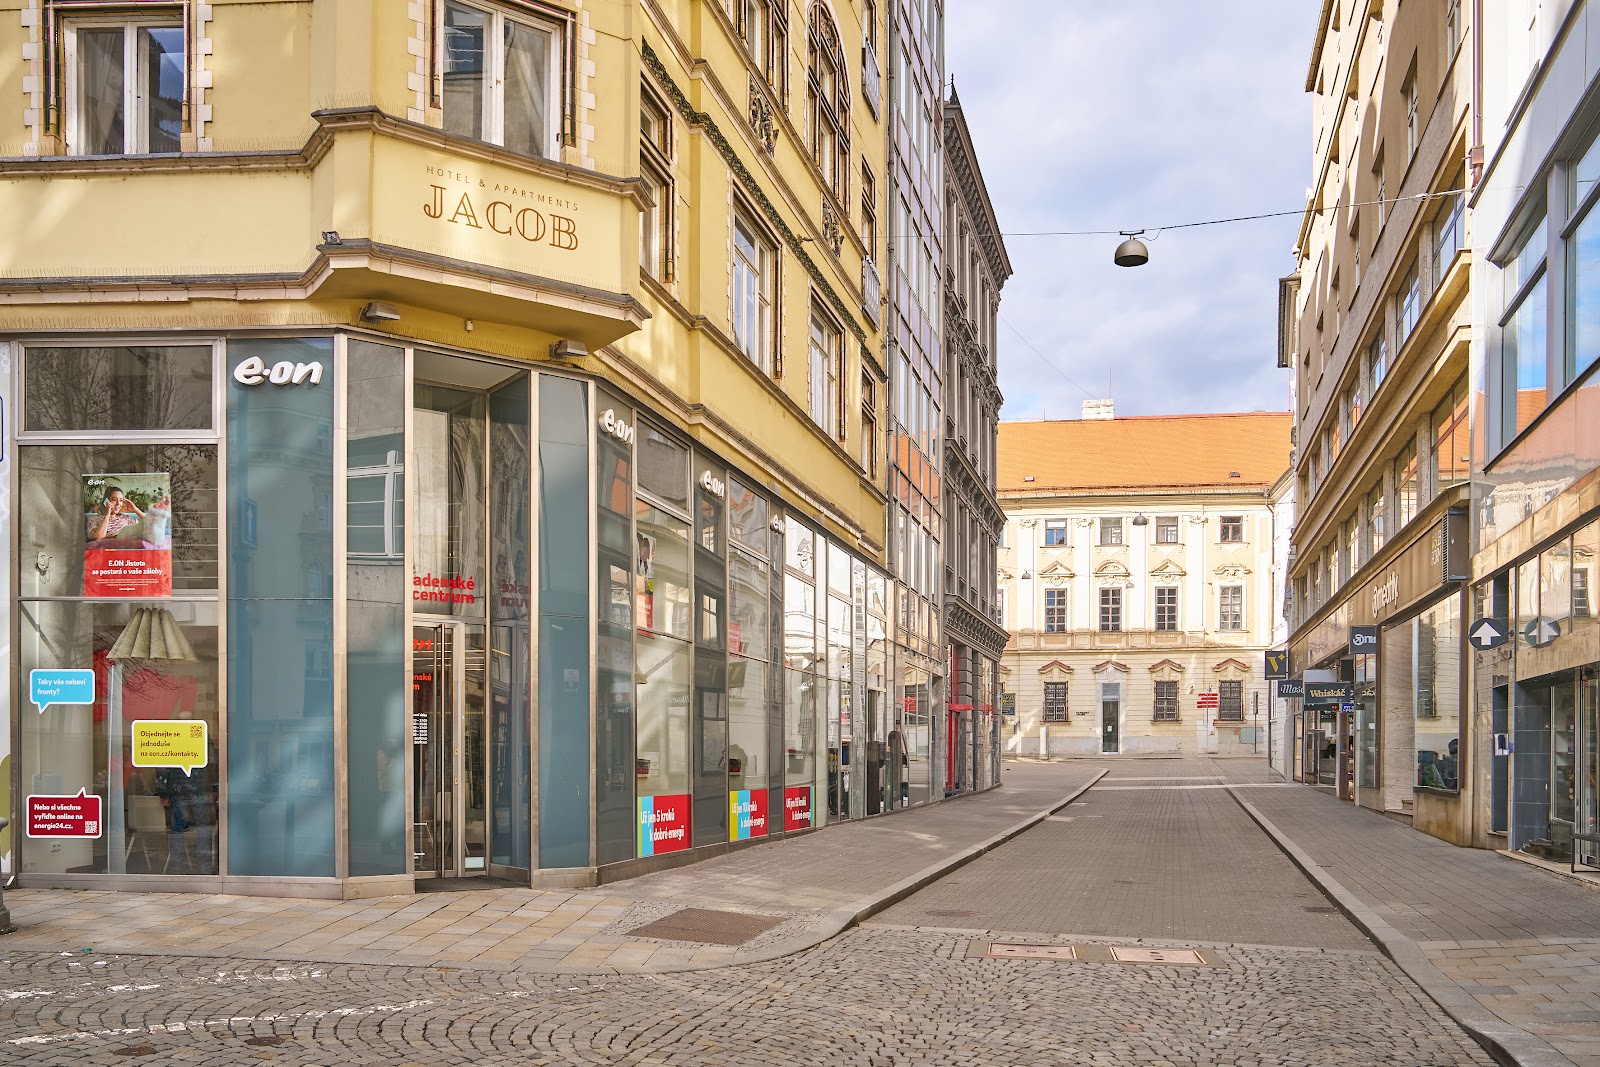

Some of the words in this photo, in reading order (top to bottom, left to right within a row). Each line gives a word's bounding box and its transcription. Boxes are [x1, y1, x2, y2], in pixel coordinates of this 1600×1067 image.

[426, 165, 469, 184] HOTEL
[478, 178, 486, 188] &
[494, 183, 578, 211] APARTMENTS
[423, 184, 578, 250] JACOB
[100, 568, 122, 577] postará
[143, 568, 163, 576] zálohy
[413, 590, 475, 604] centrum
[37, 678, 52, 687] Taky
[37, 688, 60, 696] fronty?
[1309, 688, 1346, 698] Whiskáč
[149, 750, 199, 758] eon.cz/kontakty.
[34, 812, 55, 821] vyřiďte
[56, 812, 75, 820] online
[640, 810, 648, 824] Už
[648, 811, 656, 827] jen
[656, 809, 661, 822] 5
[660, 808, 675, 822] kroků
[33, 822, 73, 830] energie24.cz.
[654, 826, 668, 841] dobré
[668, 824, 684, 840] energii
